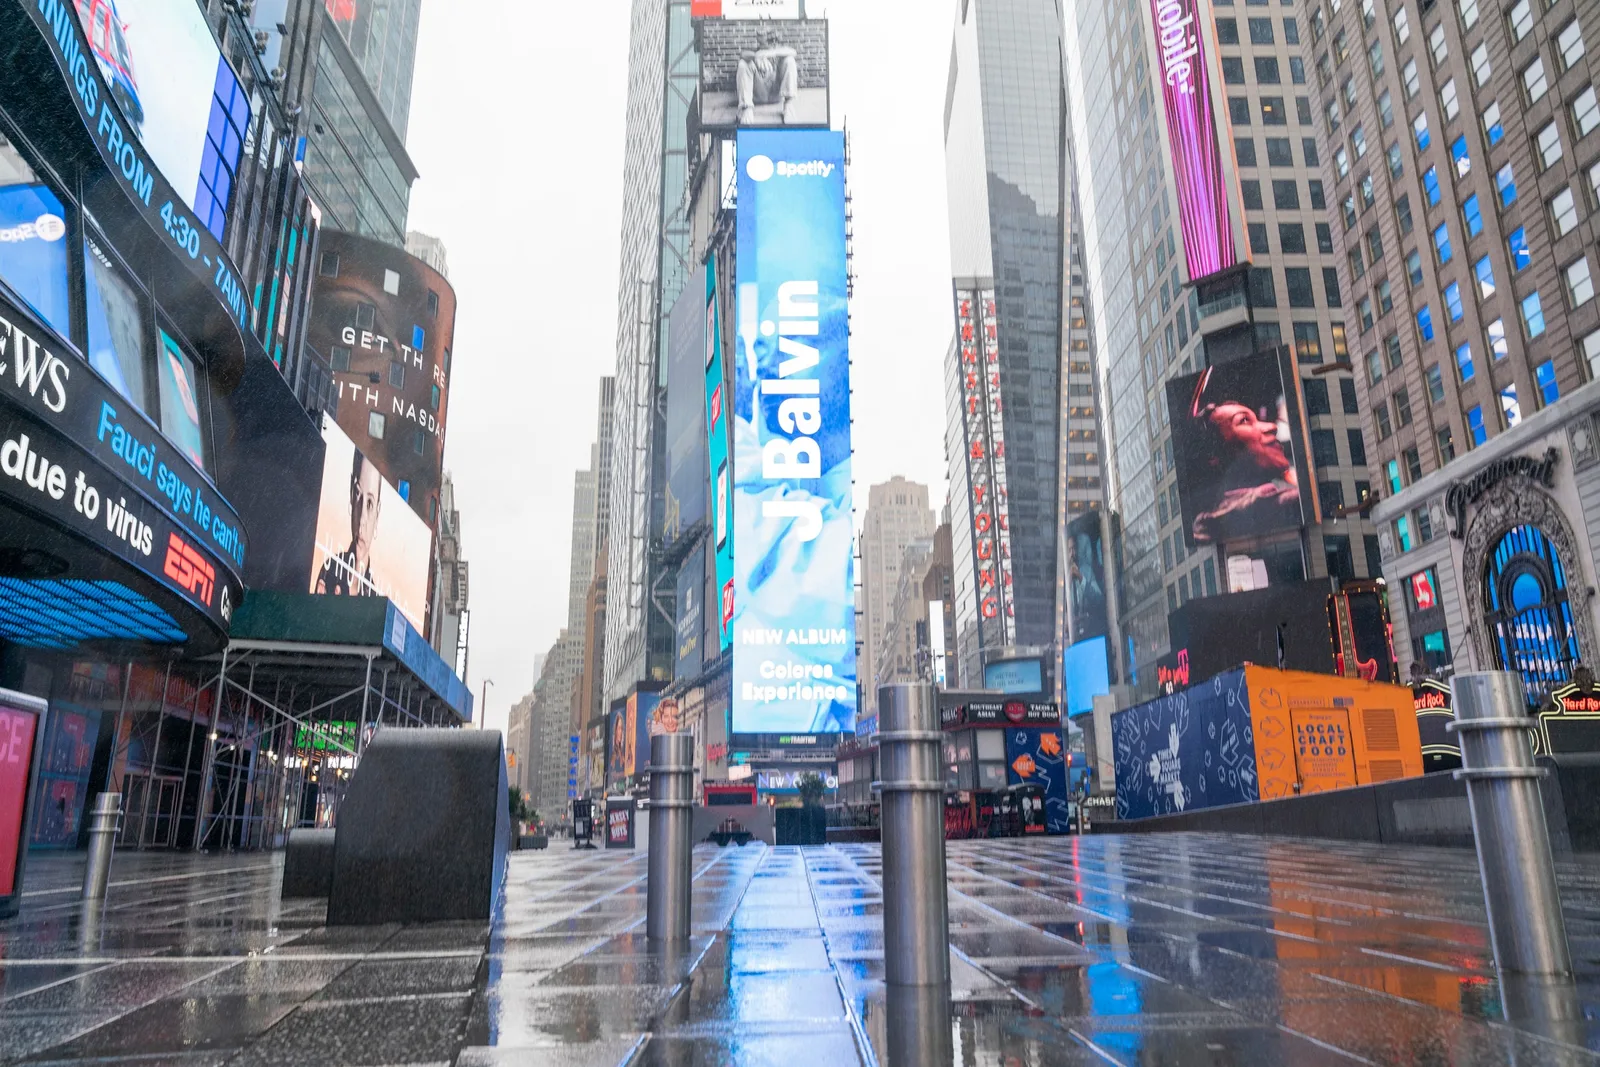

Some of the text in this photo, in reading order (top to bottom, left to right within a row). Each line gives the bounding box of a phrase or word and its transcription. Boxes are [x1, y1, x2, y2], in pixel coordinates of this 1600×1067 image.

[1157, 0, 1198, 87] obile
[38, 0, 98, 117] NINGS
[97, 102, 154, 207] FROM
[160, 201, 200, 259] 4:30
[776, 160, 834, 178] Spotify
[342, 326, 389, 354] GET
[333, 376, 445, 446] ITH NASDAQ
[760, 280, 824, 543] J Balvin
[97, 400, 156, 481] Fauci
[155, 462, 192, 515] says
[194, 488, 211, 531] he
[1, 434, 153, 556] due to virus
[974, 484, 998, 619] YOUNG
[163, 531, 216, 607] ESPN
[742, 628, 846, 645] NEW ALBUM
[759, 660, 833, 680] Colores
[742, 682, 848, 704] Experience
[1413, 690, 1445, 709] ard Rock
[1563, 697, 1586, 711] Hard
[1297, 723, 1344, 734] LOCAL
[1298, 735, 1345, 745] CRAFT
[1300, 746, 1346, 756] FOOD
[1161, 757, 1181, 772] SQUARE
[757, 773, 785, 789] NEW
[1160, 770, 1180, 784] MARKET
[609, 809, 630, 825] JERSEY
